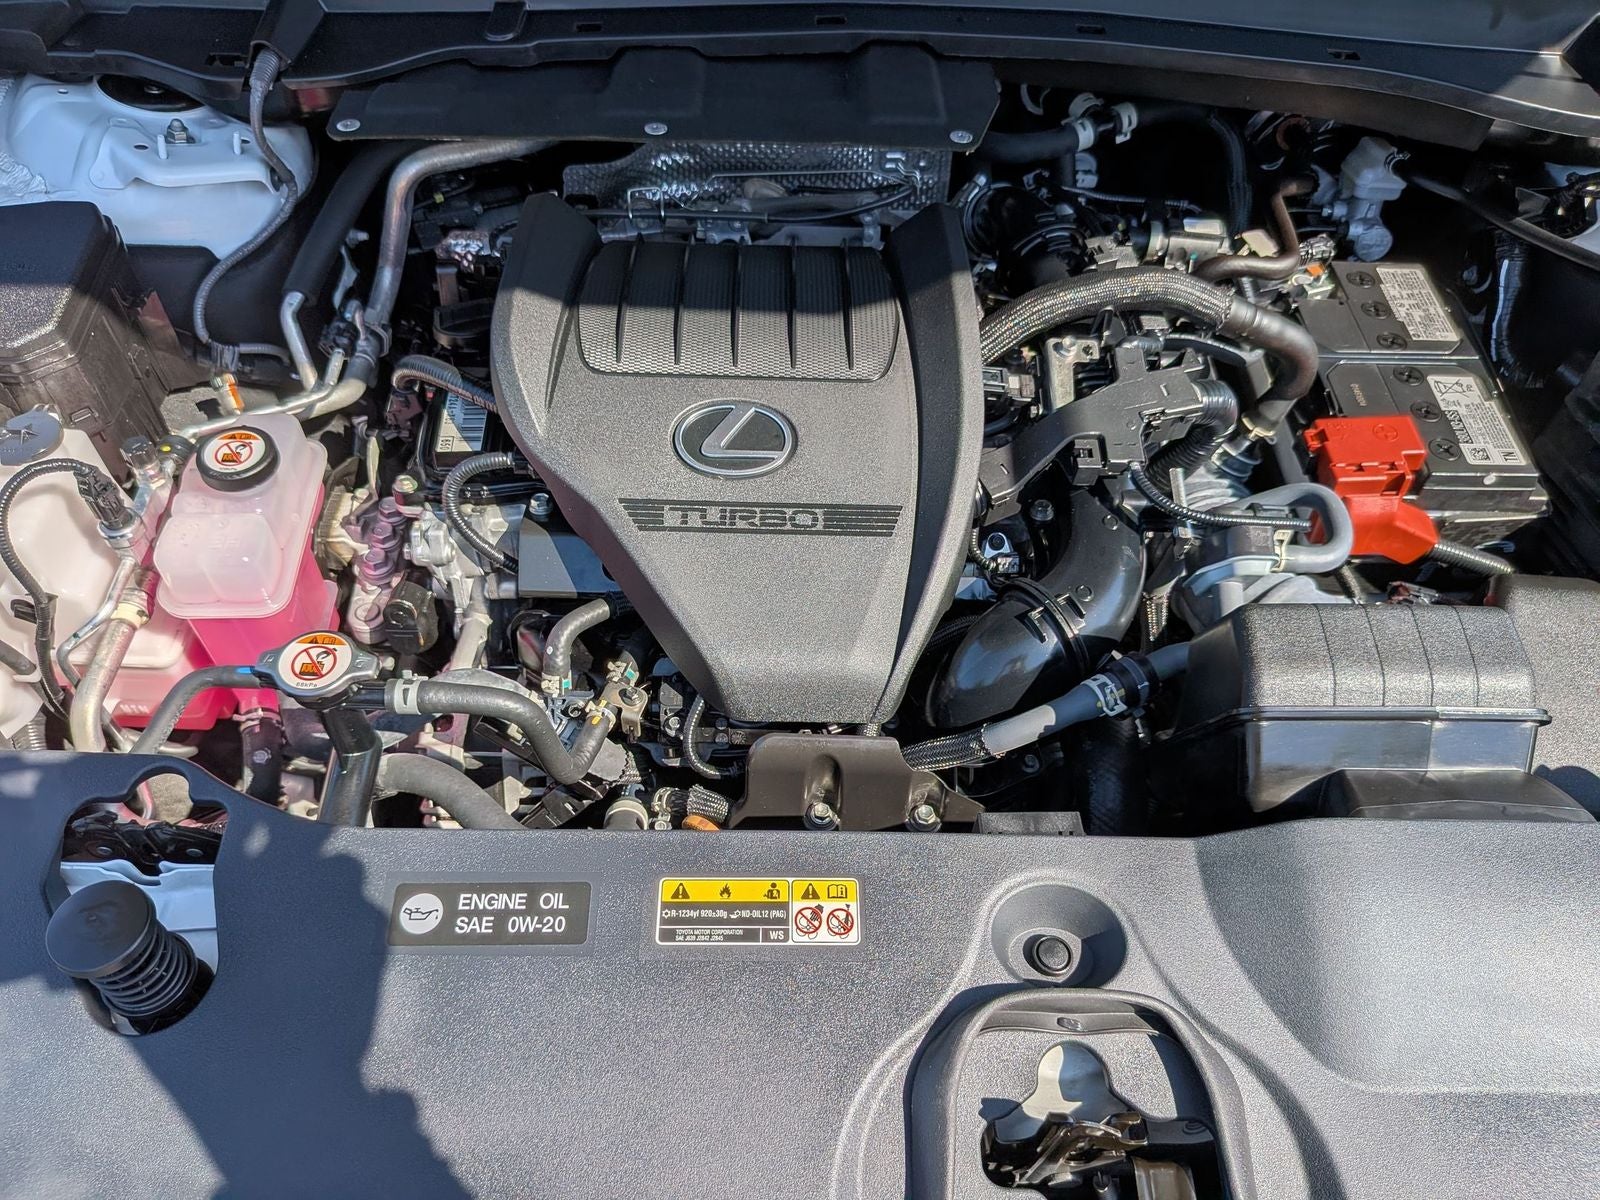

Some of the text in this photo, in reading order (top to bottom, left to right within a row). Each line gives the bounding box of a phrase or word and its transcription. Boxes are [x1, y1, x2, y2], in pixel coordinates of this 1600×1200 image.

[666, 505, 820, 529] TURBO
[458, 892, 570, 910] ENGINE OIL
[671, 909, 699, 919] R-1234yf
[700, 909, 728, 919] 920±30g
[769, 909, 787, 919] (PAG)
[455, 916, 566, 933] SAE 0W-20
[769, 930, 784, 940] WS
